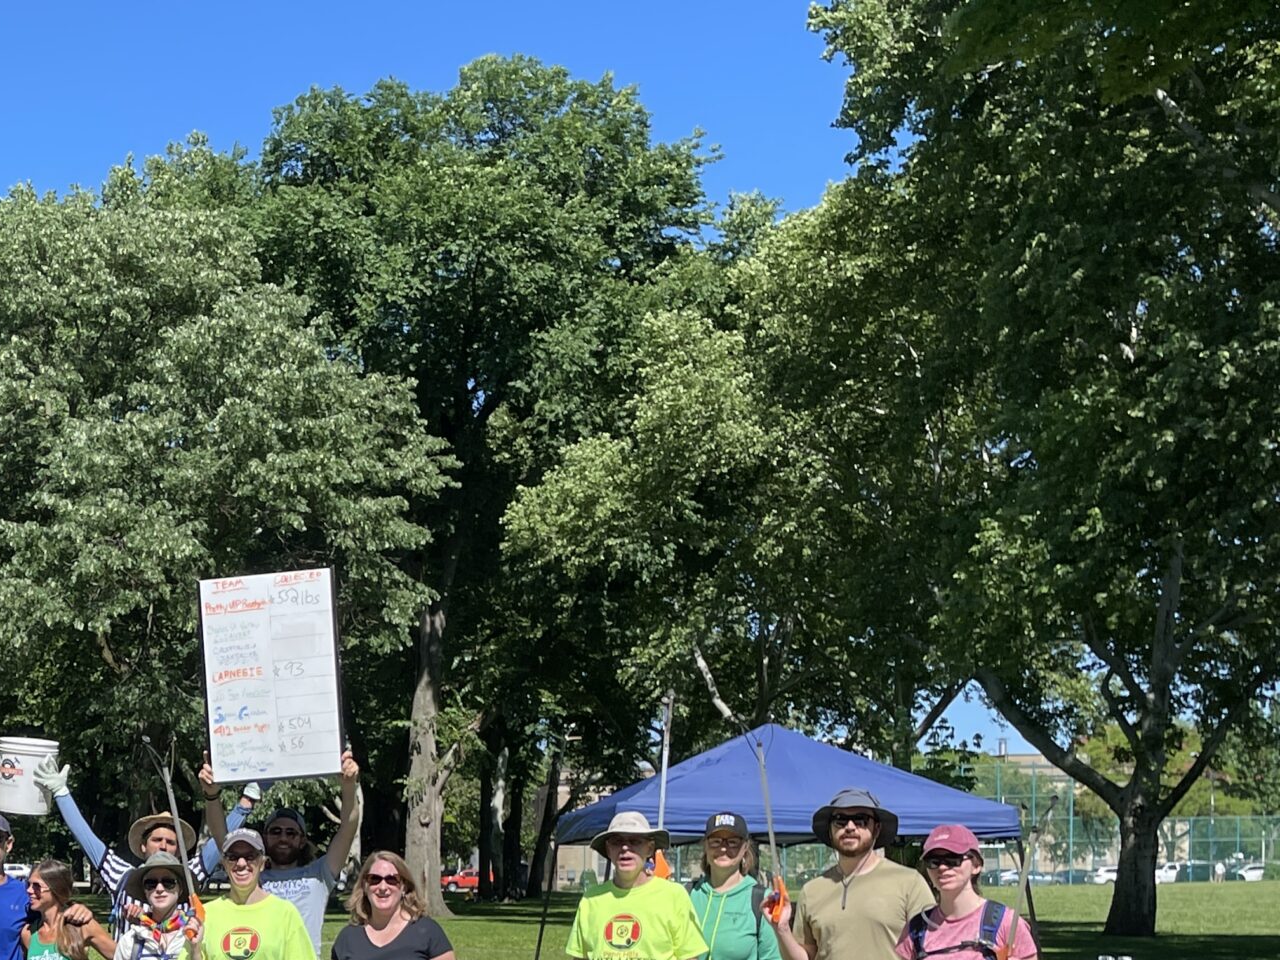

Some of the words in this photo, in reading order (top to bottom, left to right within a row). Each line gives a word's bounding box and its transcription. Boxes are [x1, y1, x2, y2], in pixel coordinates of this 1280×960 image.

[215, 579, 244, 590] TEAM
[283, 661, 305, 677] 93
[291, 736, 304, 750] 56
